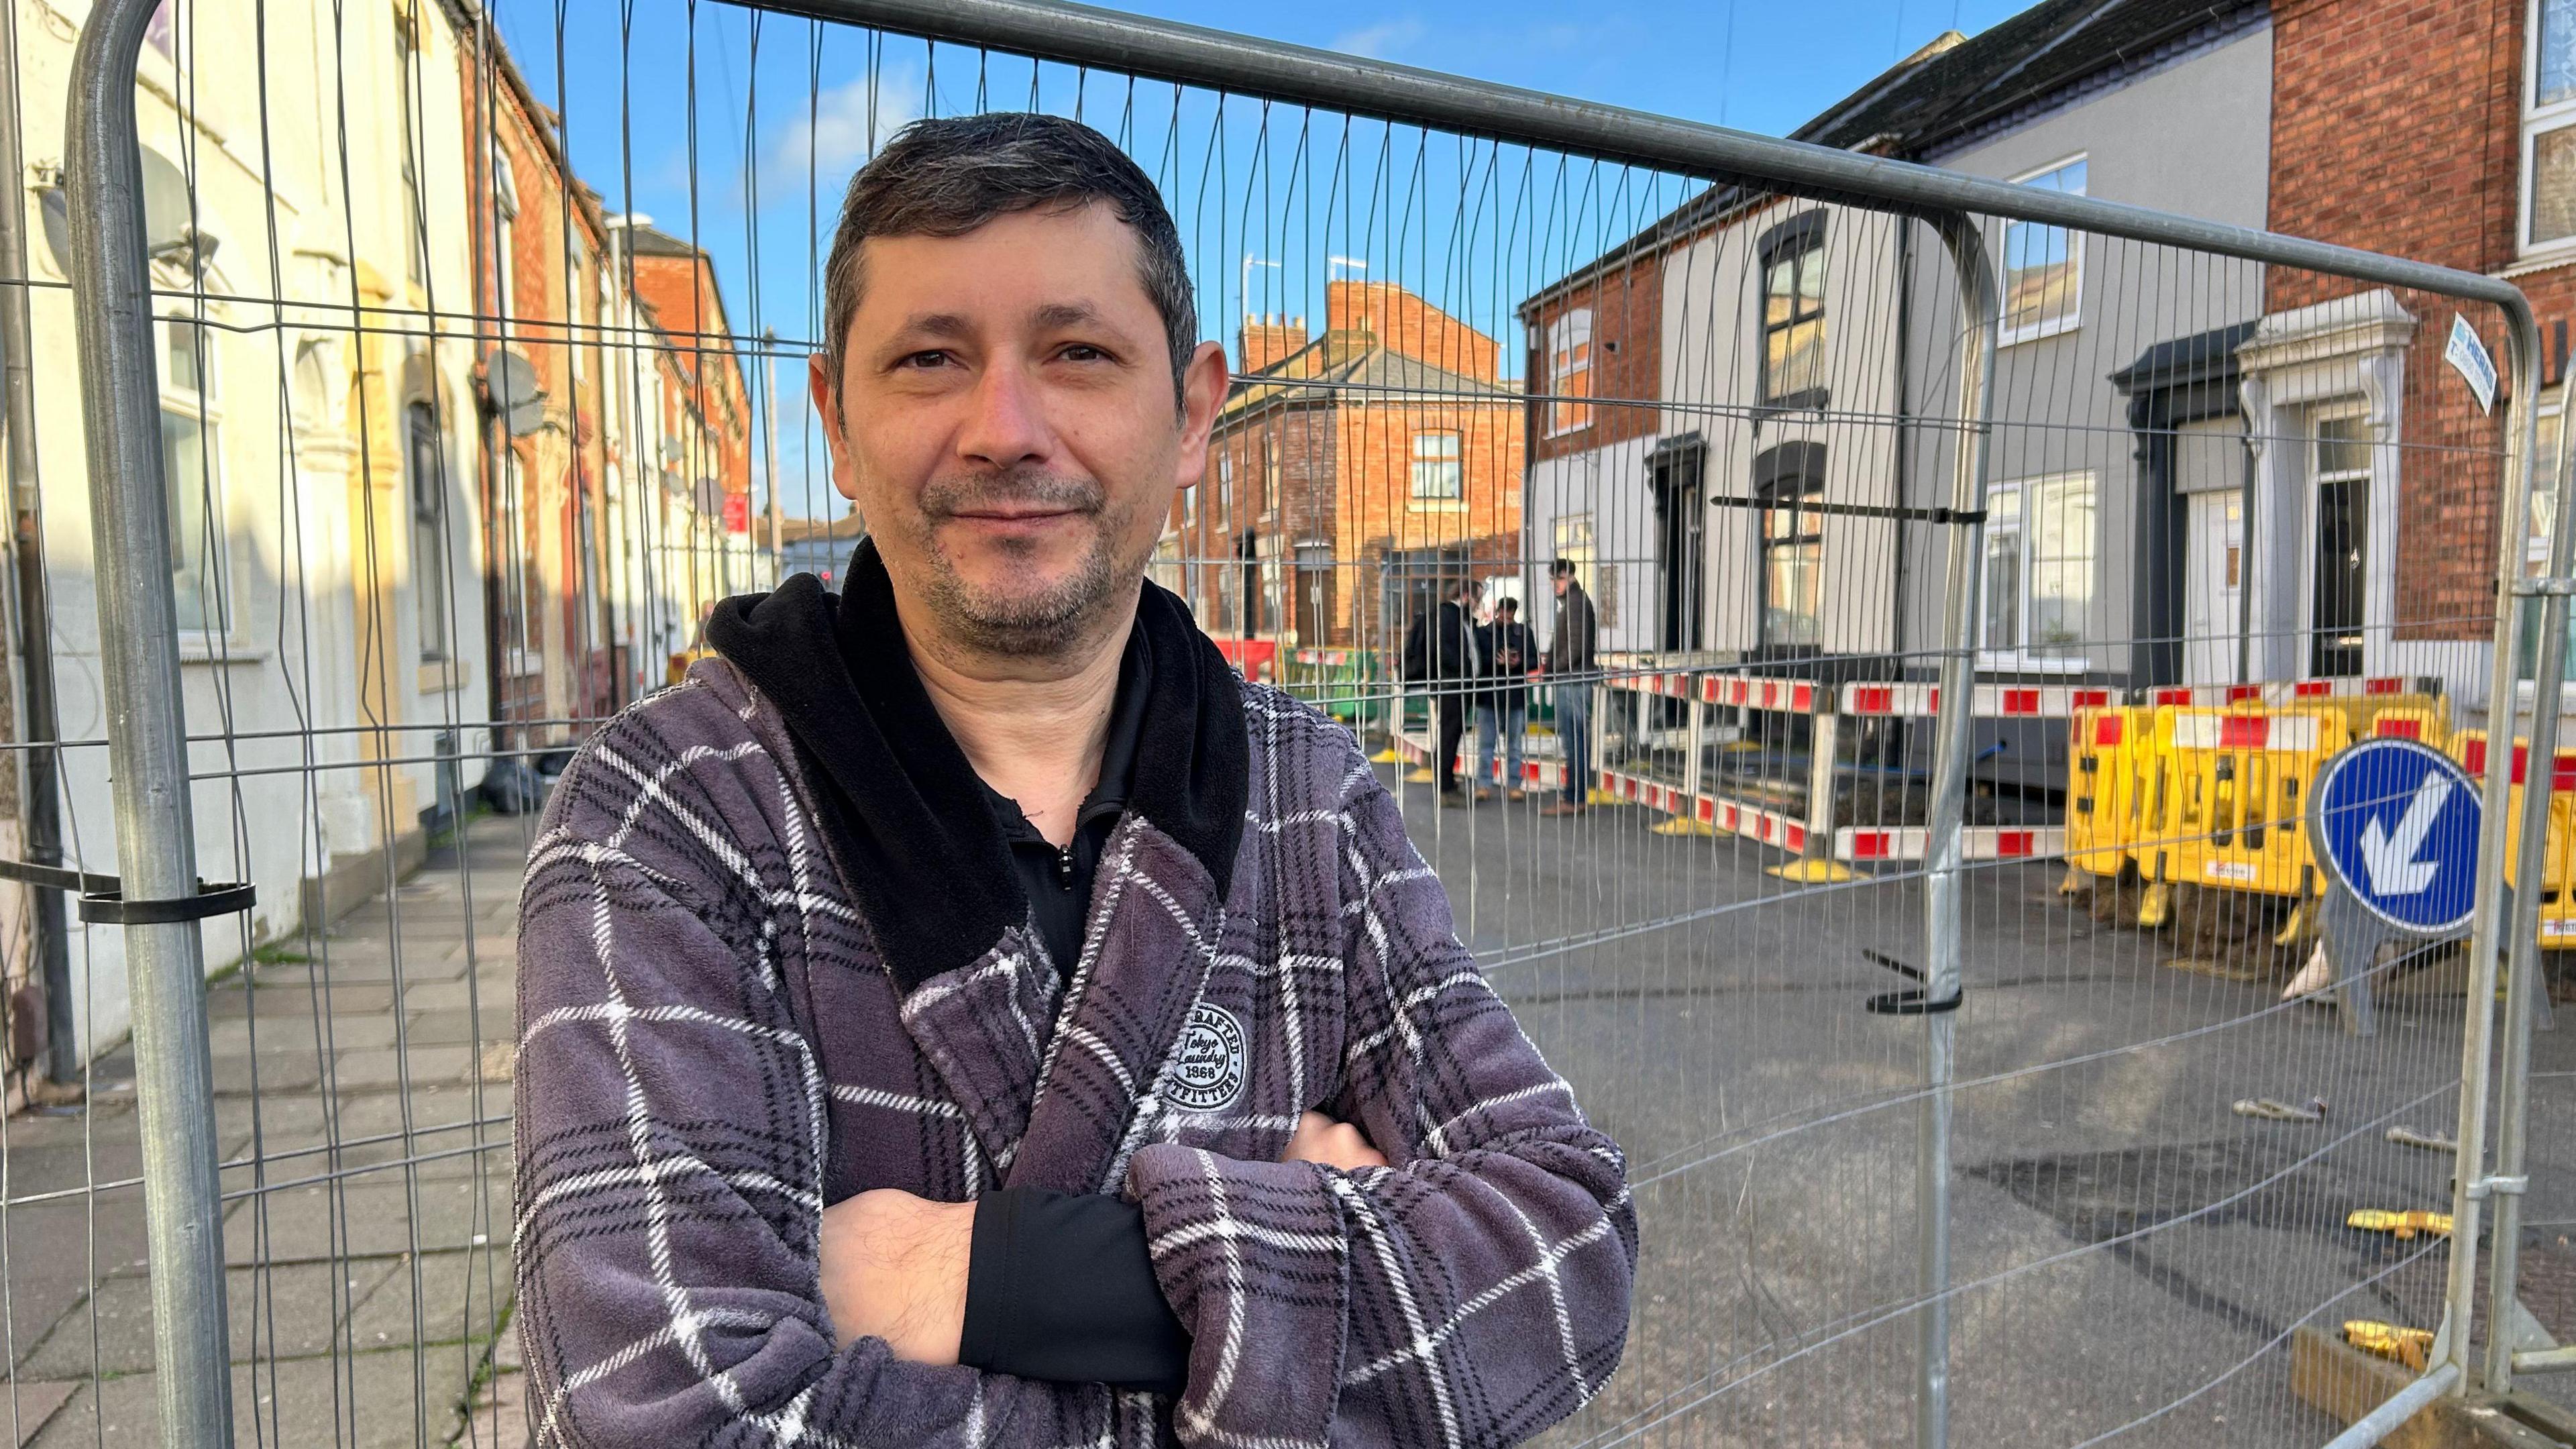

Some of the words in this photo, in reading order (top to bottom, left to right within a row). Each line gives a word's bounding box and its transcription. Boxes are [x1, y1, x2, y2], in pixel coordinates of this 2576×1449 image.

[2467, 331, 2493, 392] HERAS
[1184, 1030, 1219, 1054] Tokyo
[1191, 1010, 1240, 1054] RAFTED
[1177, 1049, 1226, 1069] Laundry
[1185, 1065, 1216, 1079] 1968
[1165, 1071, 1239, 1103] TFITTERS
